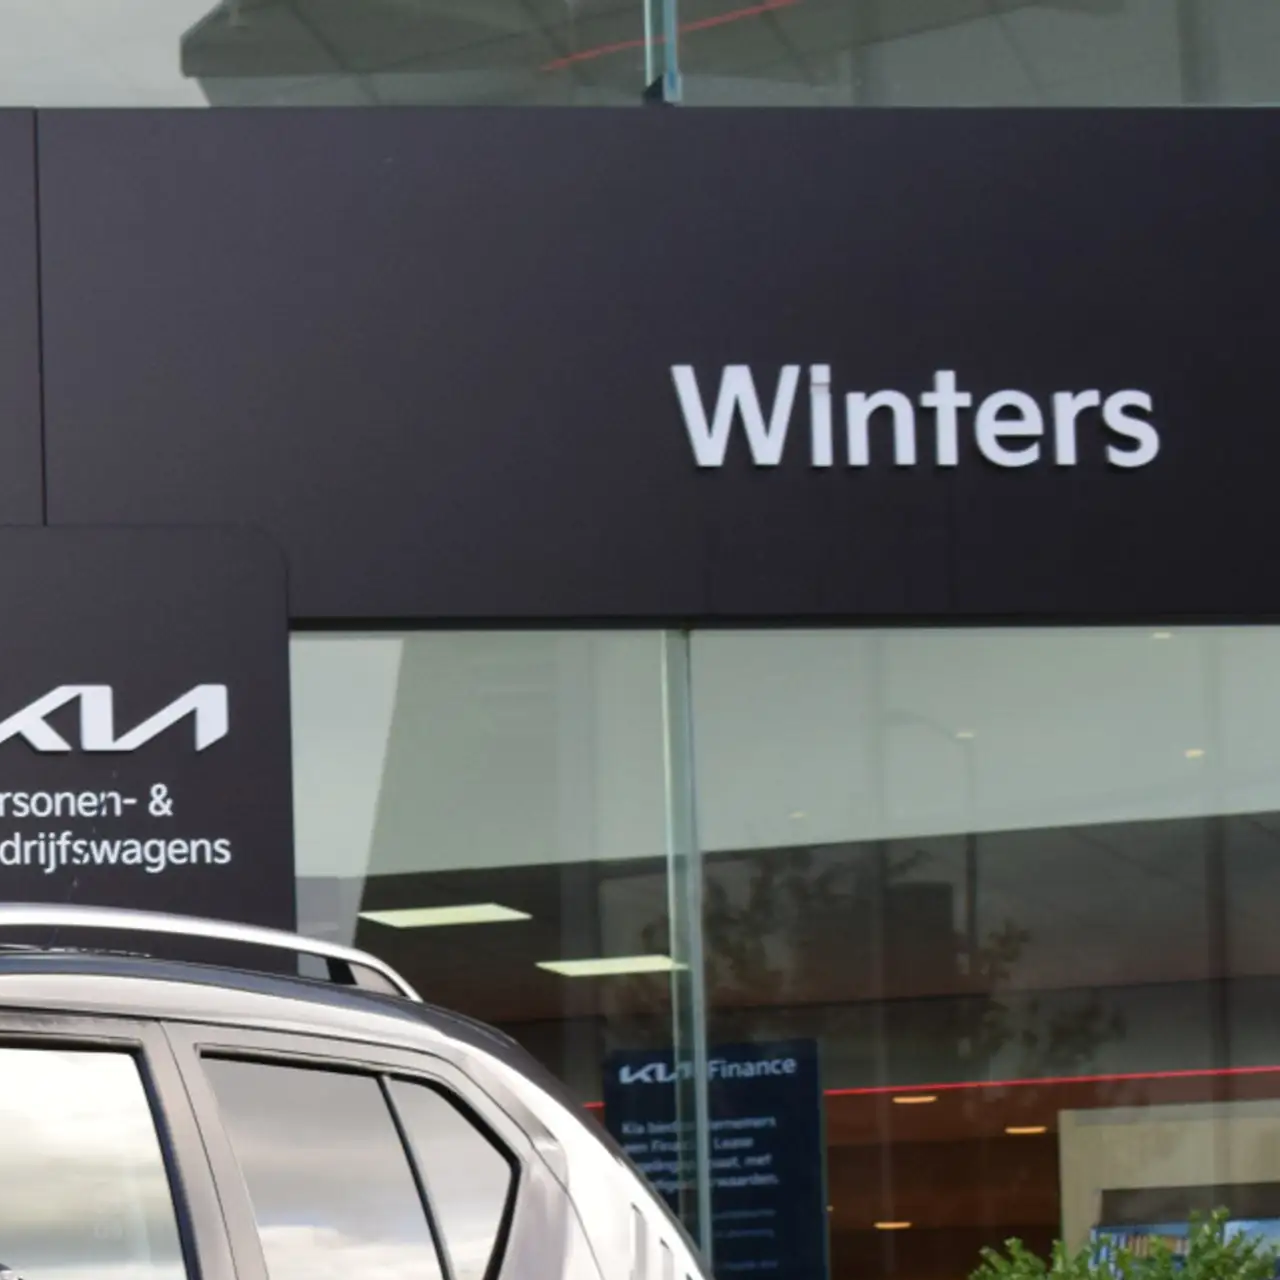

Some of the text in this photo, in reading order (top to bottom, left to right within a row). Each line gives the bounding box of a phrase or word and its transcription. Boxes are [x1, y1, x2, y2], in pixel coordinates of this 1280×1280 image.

[670, 363, 1161, 468] Winters
[147, 782, 175, 817] &
[707, 1056, 798, 1080] Finance
